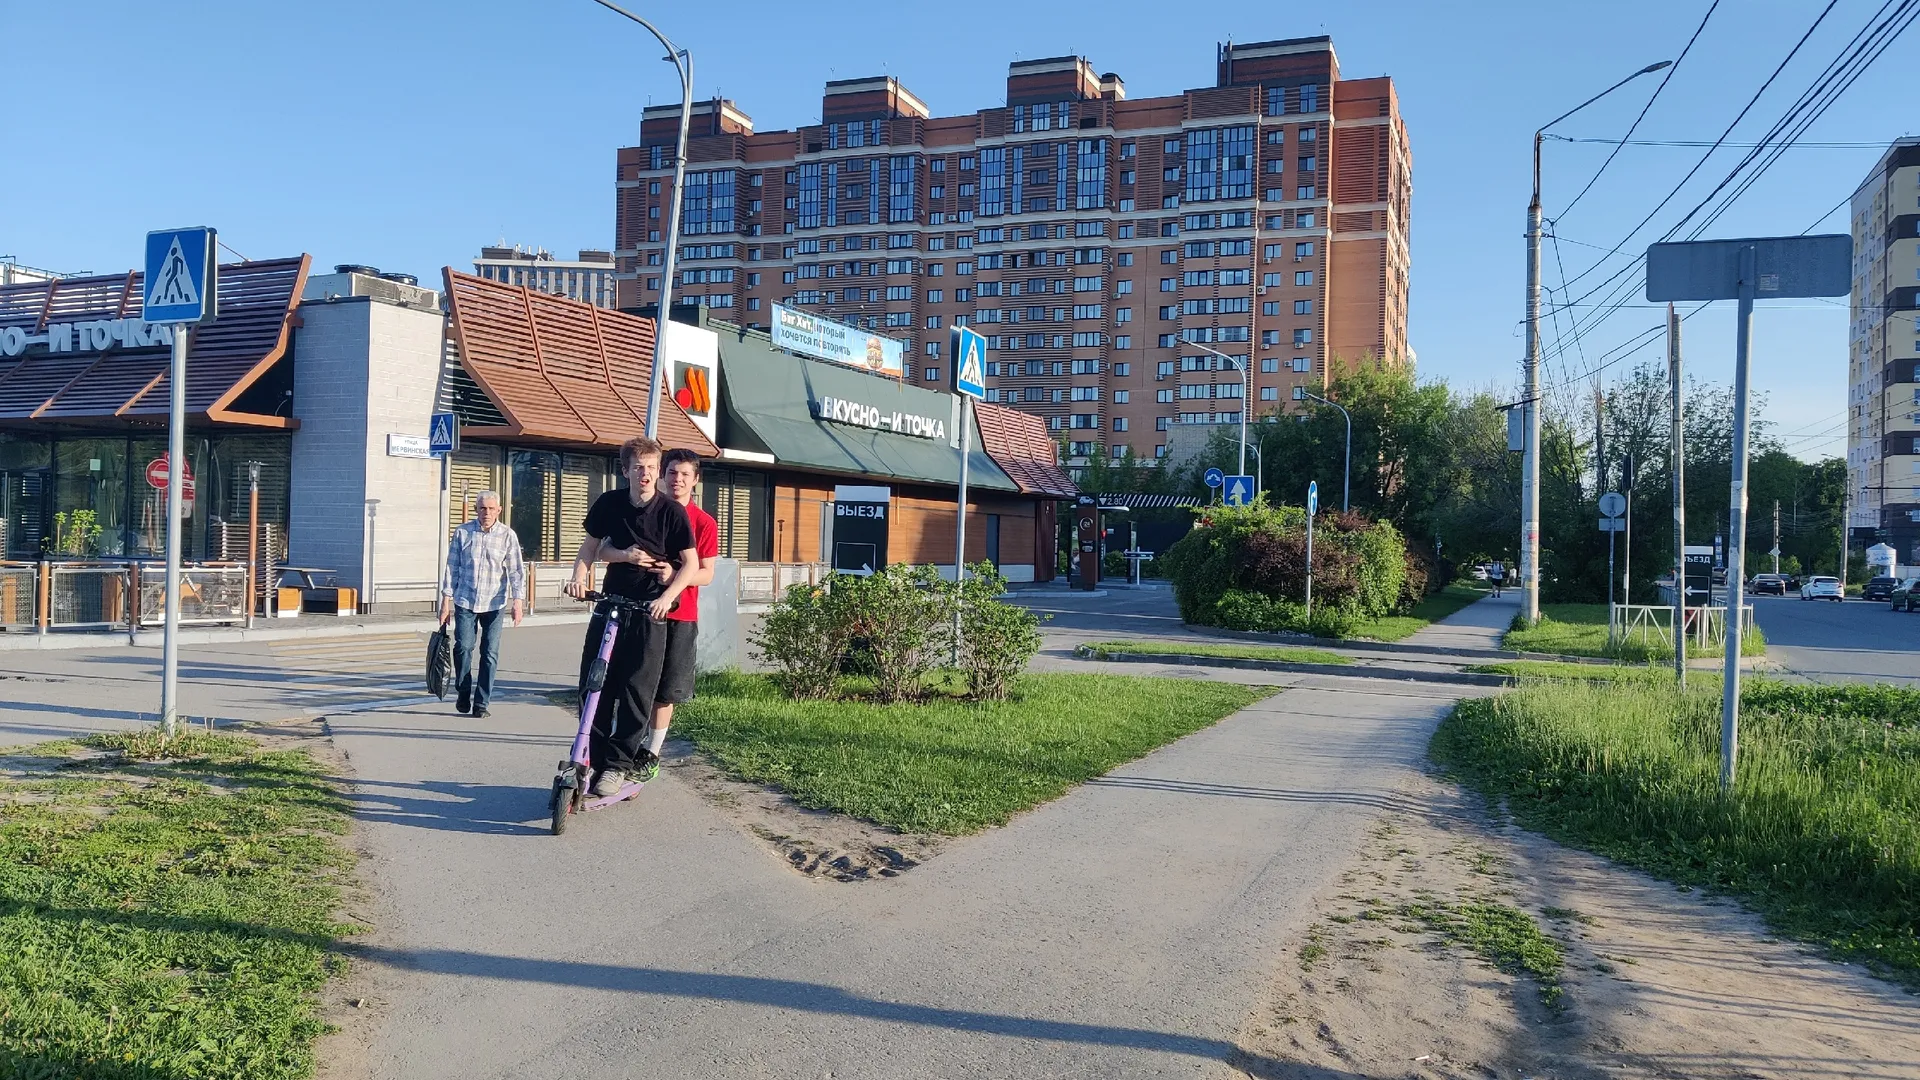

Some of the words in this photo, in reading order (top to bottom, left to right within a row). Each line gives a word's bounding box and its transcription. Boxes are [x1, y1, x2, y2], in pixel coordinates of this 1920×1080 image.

[0, 326, 25, 356] О
[49, 323, 72, 352] И
[74, 320, 173, 350] ТОЧКА
[780, 329, 812, 346] хочется
[821, 396, 880, 428] ВКУСНО
[892, 411, 902, 433] И
[904, 413, 945, 439] ТОЧКА
[836, 504, 885, 520] ВЫЕЗД
[1684, 555, 1711, 564] ЪЕЗД
